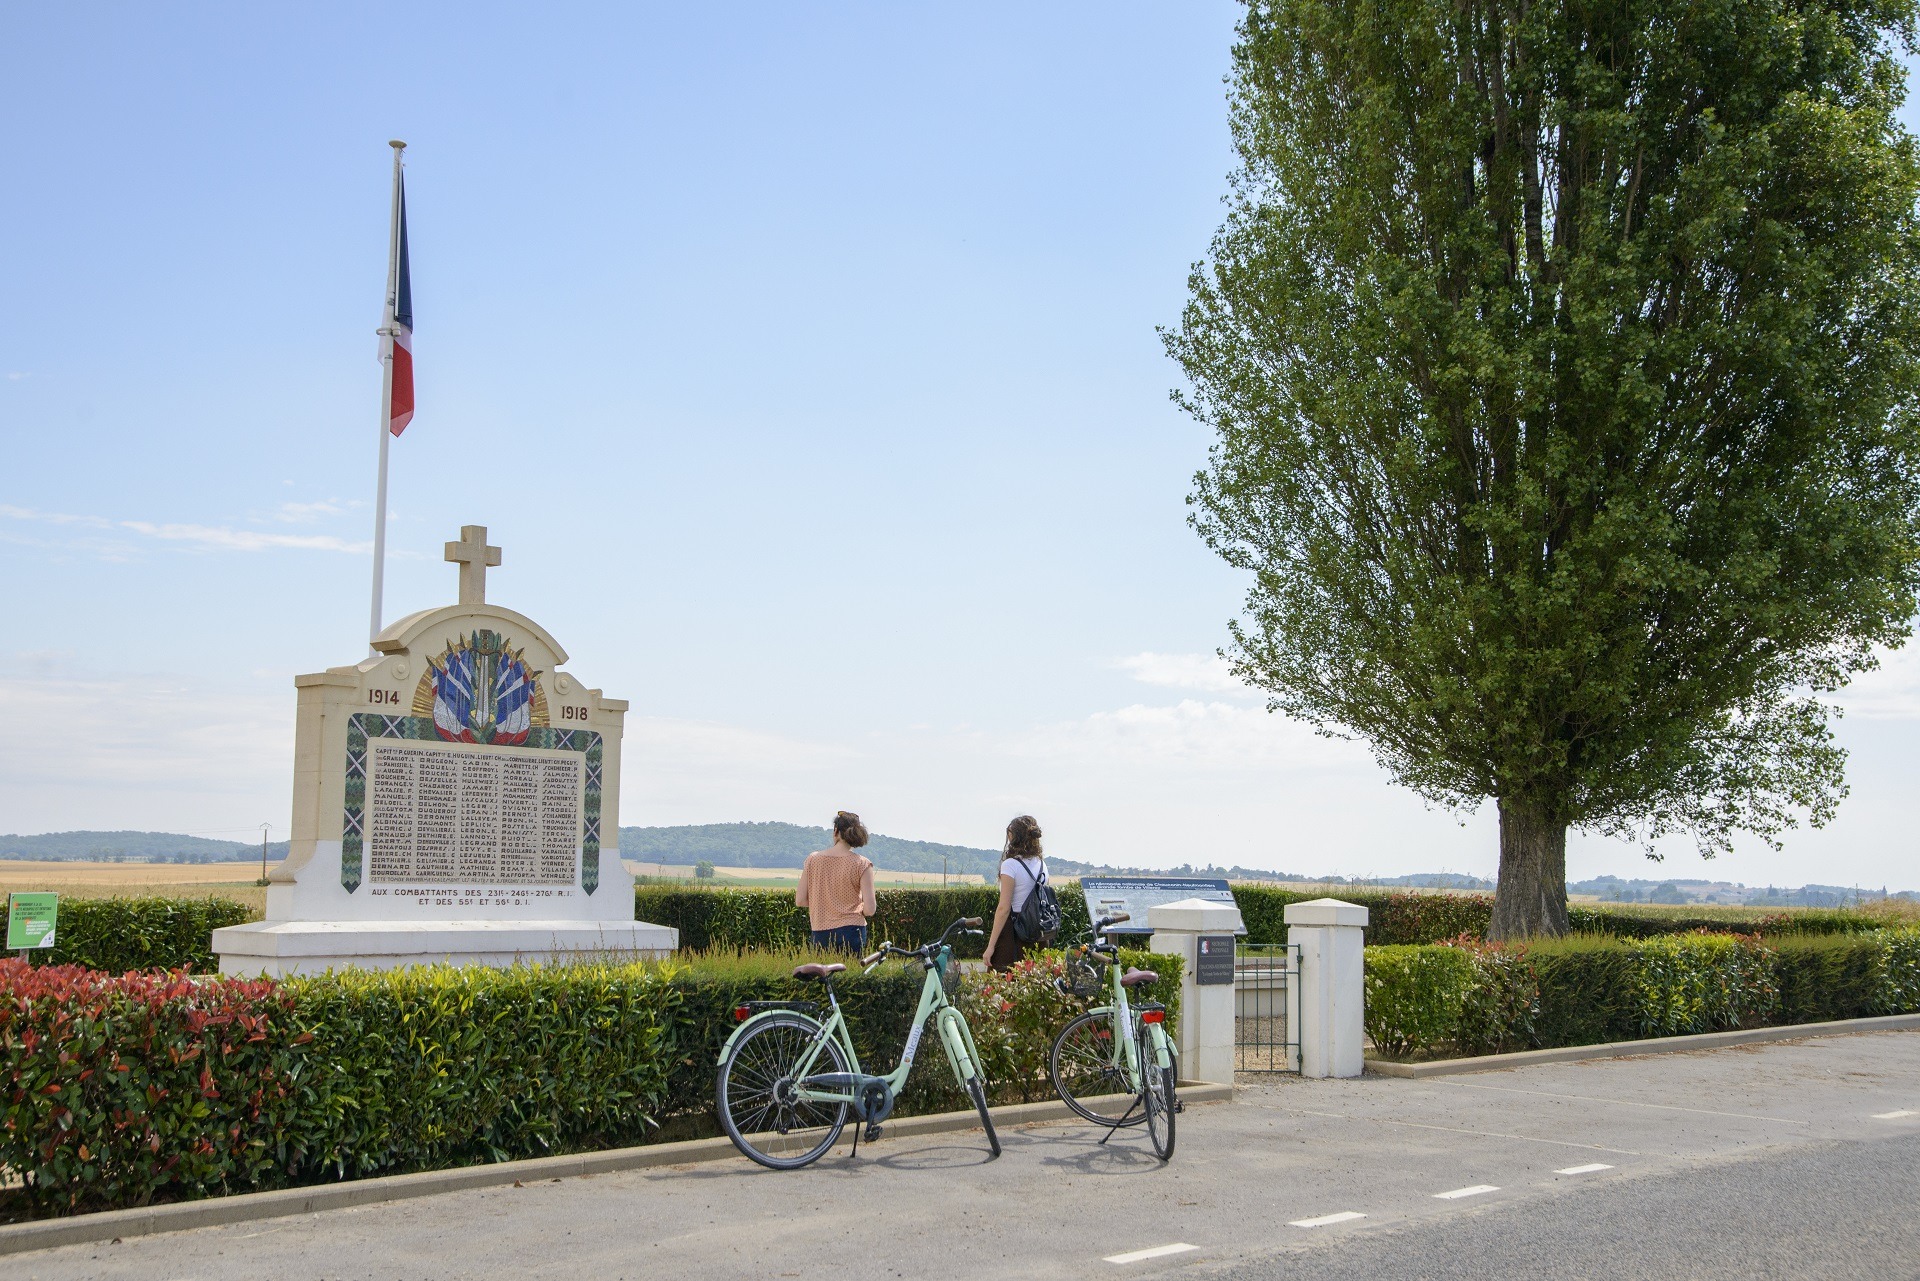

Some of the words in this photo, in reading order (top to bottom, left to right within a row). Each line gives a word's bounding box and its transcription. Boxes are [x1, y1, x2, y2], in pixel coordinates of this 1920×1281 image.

[369, 689, 400, 705] 1914
[562, 705, 588, 721] 1918
[906, 1026, 922, 1058] Meaux
